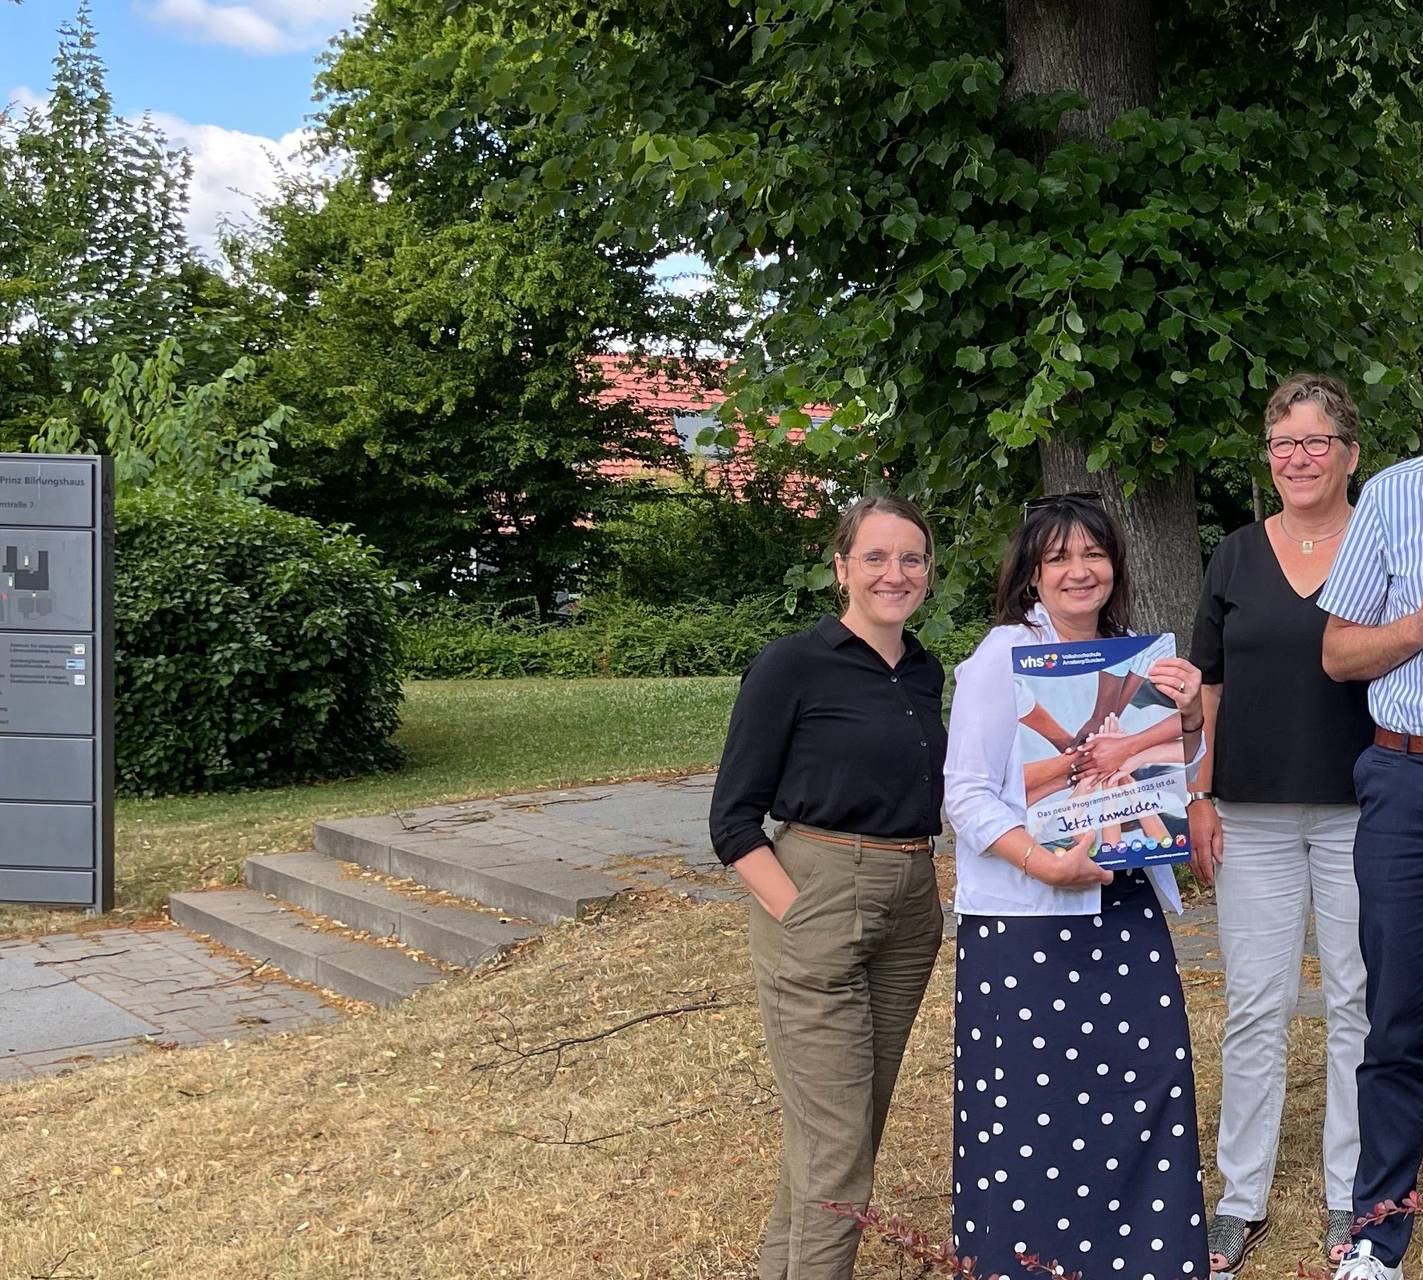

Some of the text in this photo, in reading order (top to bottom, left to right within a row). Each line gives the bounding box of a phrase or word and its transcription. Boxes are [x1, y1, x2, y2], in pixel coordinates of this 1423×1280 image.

[24, 476, 85, 488] Bildungshaus
[1019, 656, 1045, 669] vhs
[1037, 810, 1051, 818] Das
[1053, 806, 1071, 815] neue
[1072, 795, 1110, 810] Programm
[1111, 788, 1136, 800] Herbst
[1137, 784, 1155, 793] 2025
[1156, 781, 1165, 789] ist
[1057, 792, 1164, 832] Jetzt anmelden!
